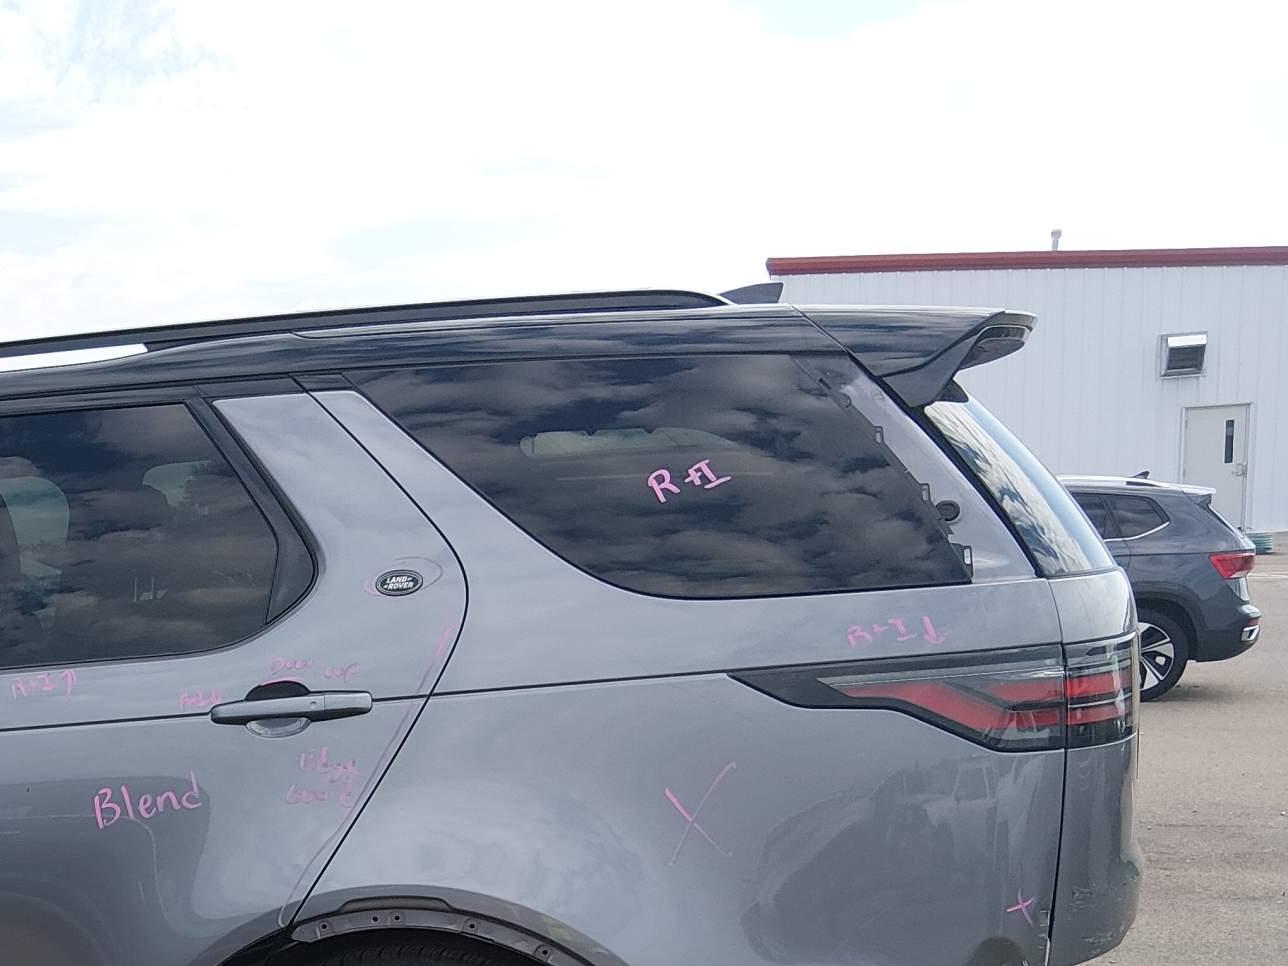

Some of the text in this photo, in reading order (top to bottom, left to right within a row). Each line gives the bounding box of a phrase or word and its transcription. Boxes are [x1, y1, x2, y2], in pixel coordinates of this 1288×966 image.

[385, 575, 408, 584] LAND
[387, 581, 414, 590] ROVER
[93, 768, 203, 830] Blend
